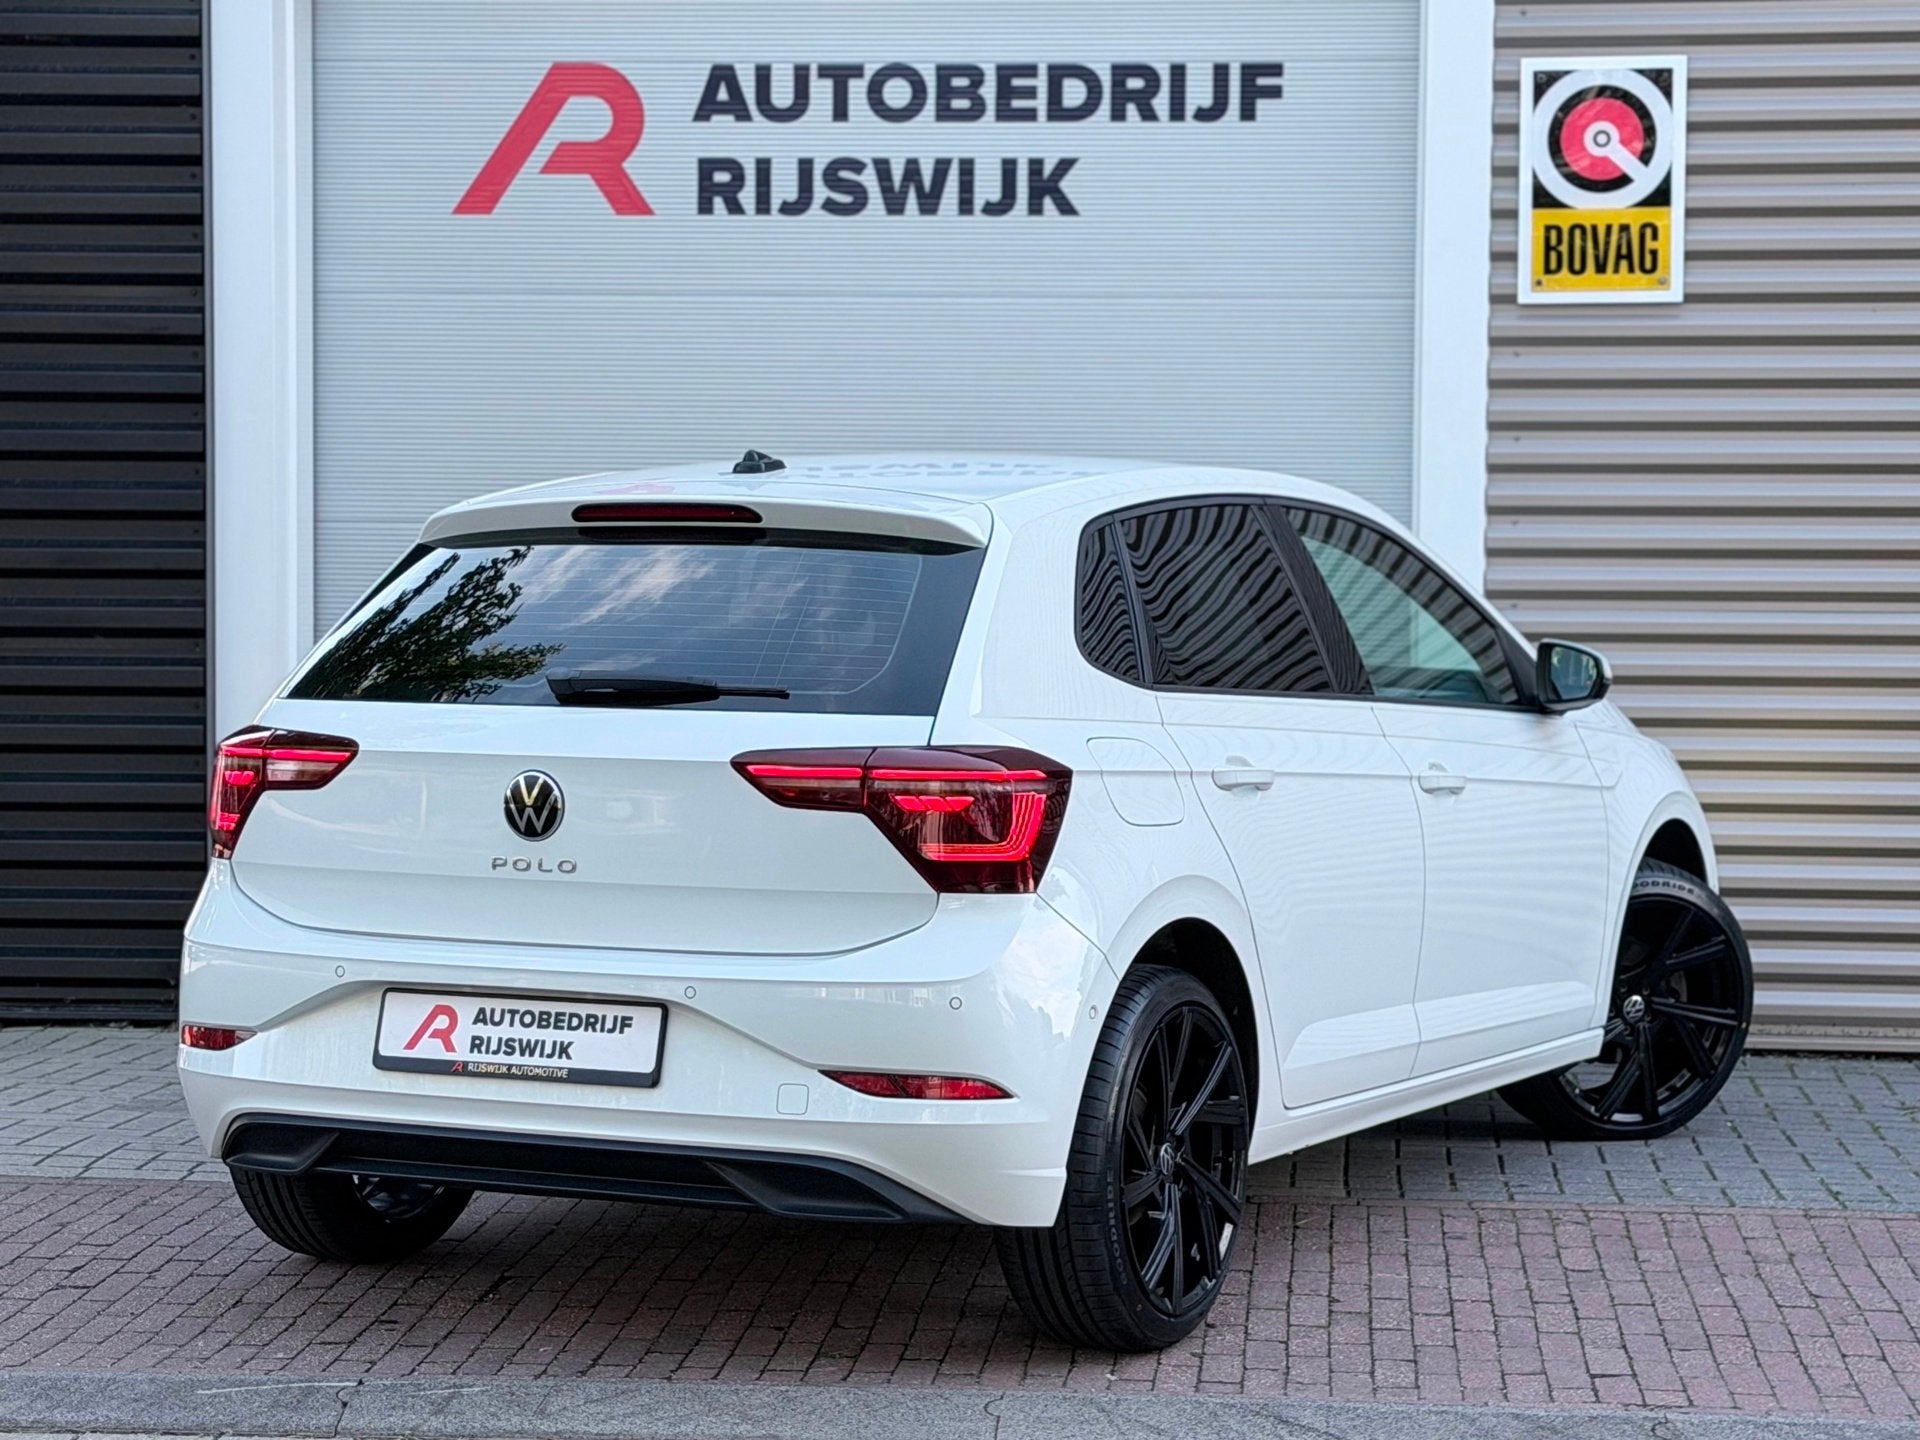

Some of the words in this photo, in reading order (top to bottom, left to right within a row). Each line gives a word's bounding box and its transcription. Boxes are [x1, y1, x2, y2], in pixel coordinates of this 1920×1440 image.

[692, 62, 1284, 123] AUTOBEDRIJF
[698, 157, 1079, 217] RIJSWIJK
[1543, 222, 1659, 276] BOVAG
[491, 856, 578, 874] POLO
[1632, 880, 1695, 895] ODRIDE
[472, 1007, 634, 1035] AUTOBEDRIJF
[469, 1035, 574, 1060] RIJSWIJK
[467, 1063, 508, 1074] RIJSWIJK
[510, 1067, 569, 1078] AUTOMOTIVE
